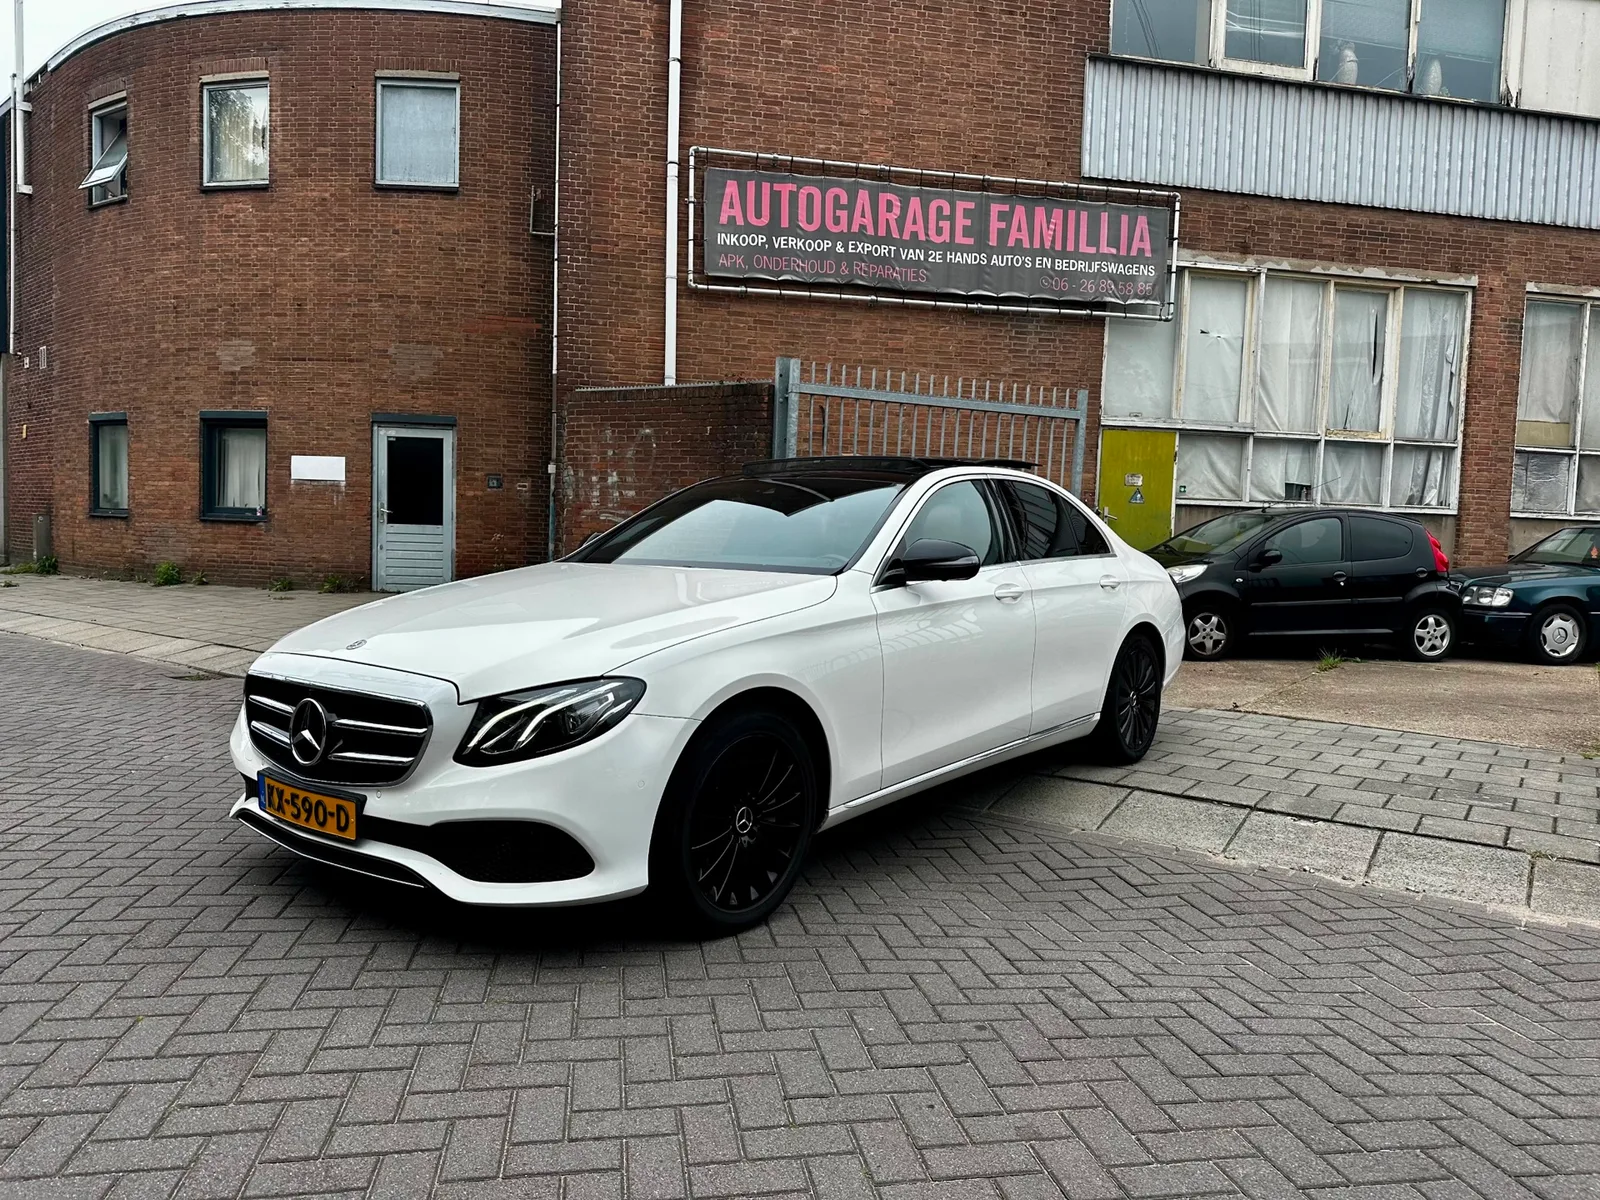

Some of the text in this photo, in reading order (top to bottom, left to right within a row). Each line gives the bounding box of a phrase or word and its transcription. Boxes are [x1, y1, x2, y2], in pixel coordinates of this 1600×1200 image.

[719, 180, 1152, 257] AUTOGARAGE FAMILLIA
[717, 233, 1155, 276] INKOOP, VERKOOP & EXPORT VAN 2E HANDS AUTO'S EN BEDRIJFSWAGENS
[718, 253, 927, 282] APK, ONDERHOUD & REPARATIES
[1079, 278, 1095, 293] 26
[1118, 281, 1134, 295] 58
[1137, 282, 1153, 296] 85
